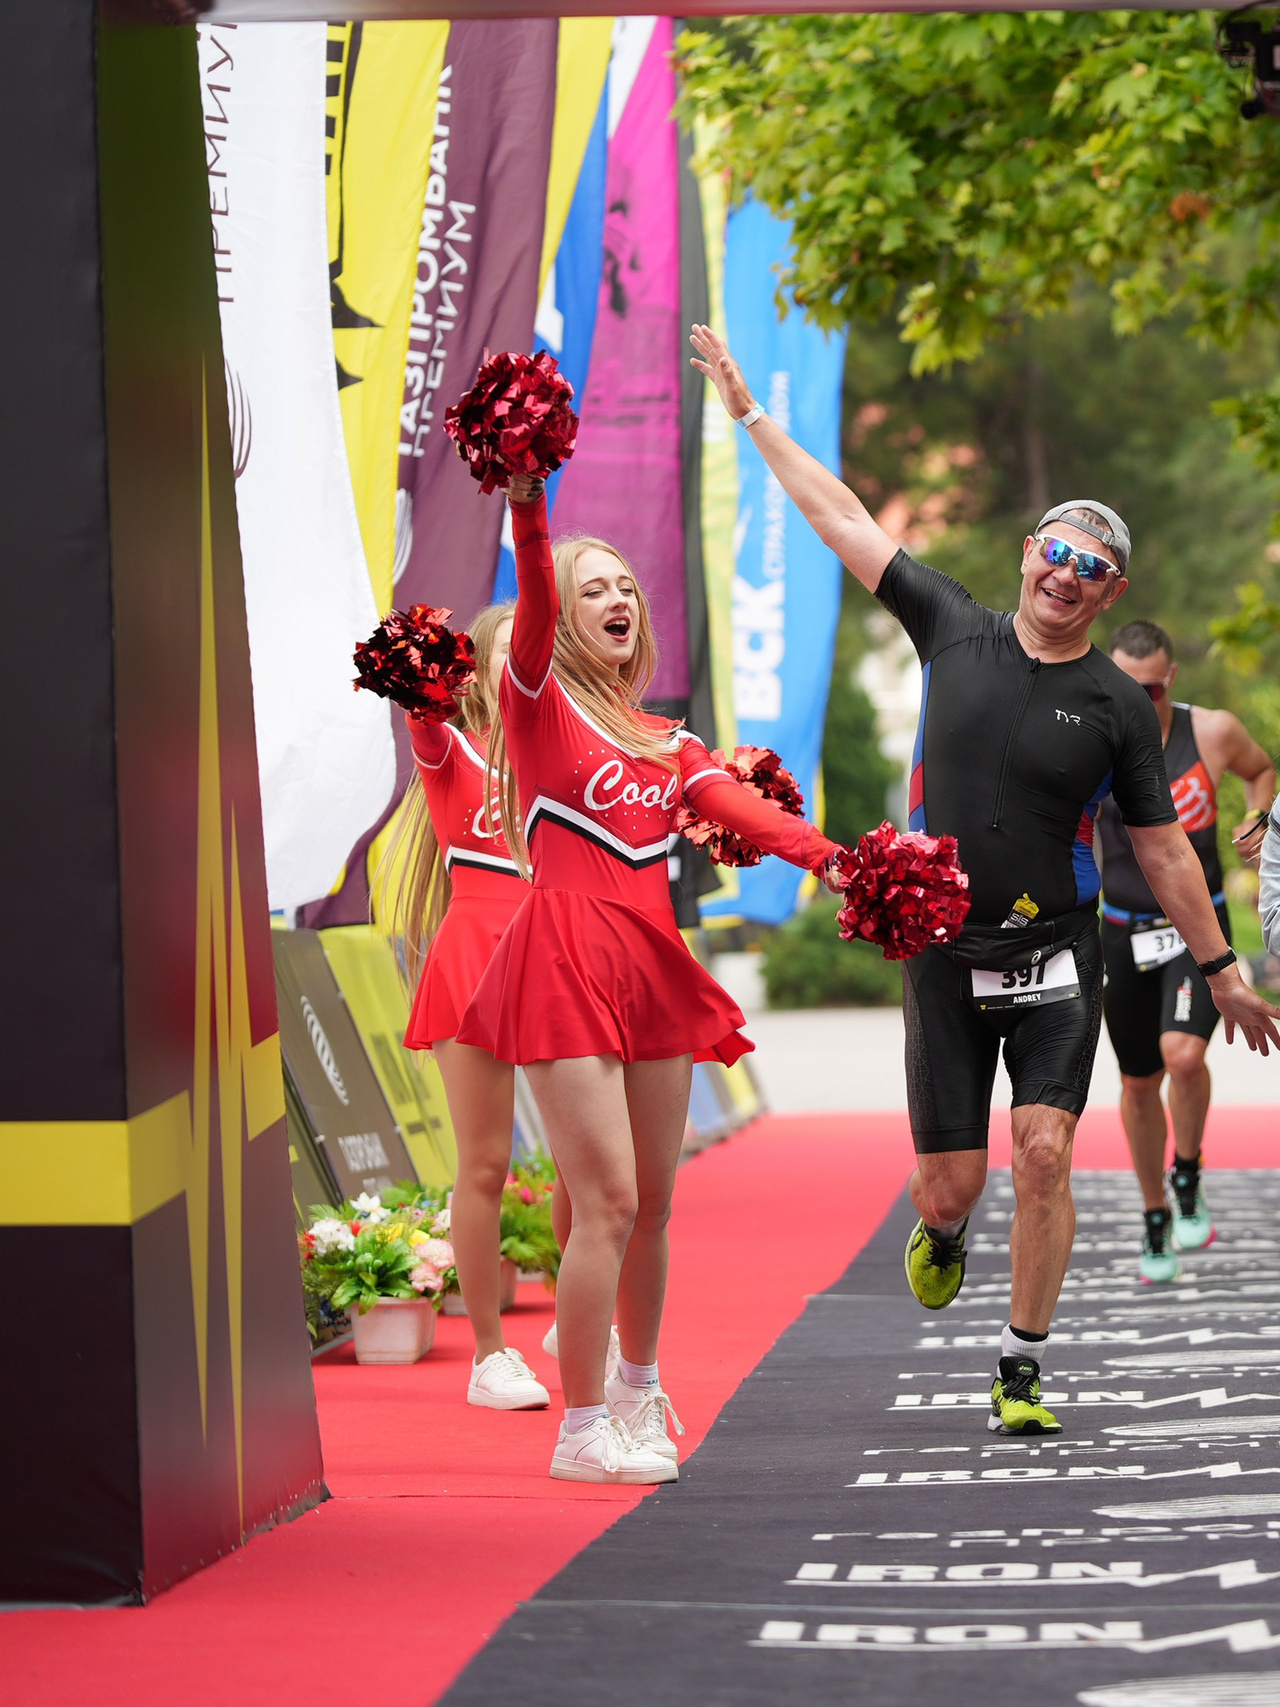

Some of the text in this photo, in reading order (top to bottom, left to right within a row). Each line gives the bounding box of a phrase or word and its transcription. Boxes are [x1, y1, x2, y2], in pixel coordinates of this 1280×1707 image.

[204, 22, 238, 303] ПРЕМИУ
[1055, 709, 1081, 726] TYR
[584, 760, 679, 811] Cool
[1013, 992, 1042, 1005] ANDREY
[854, 1464, 1145, 1485] IRON
[794, 1561, 1144, 1581] IRON
[758, 1620, 1144, 1644] IRON
